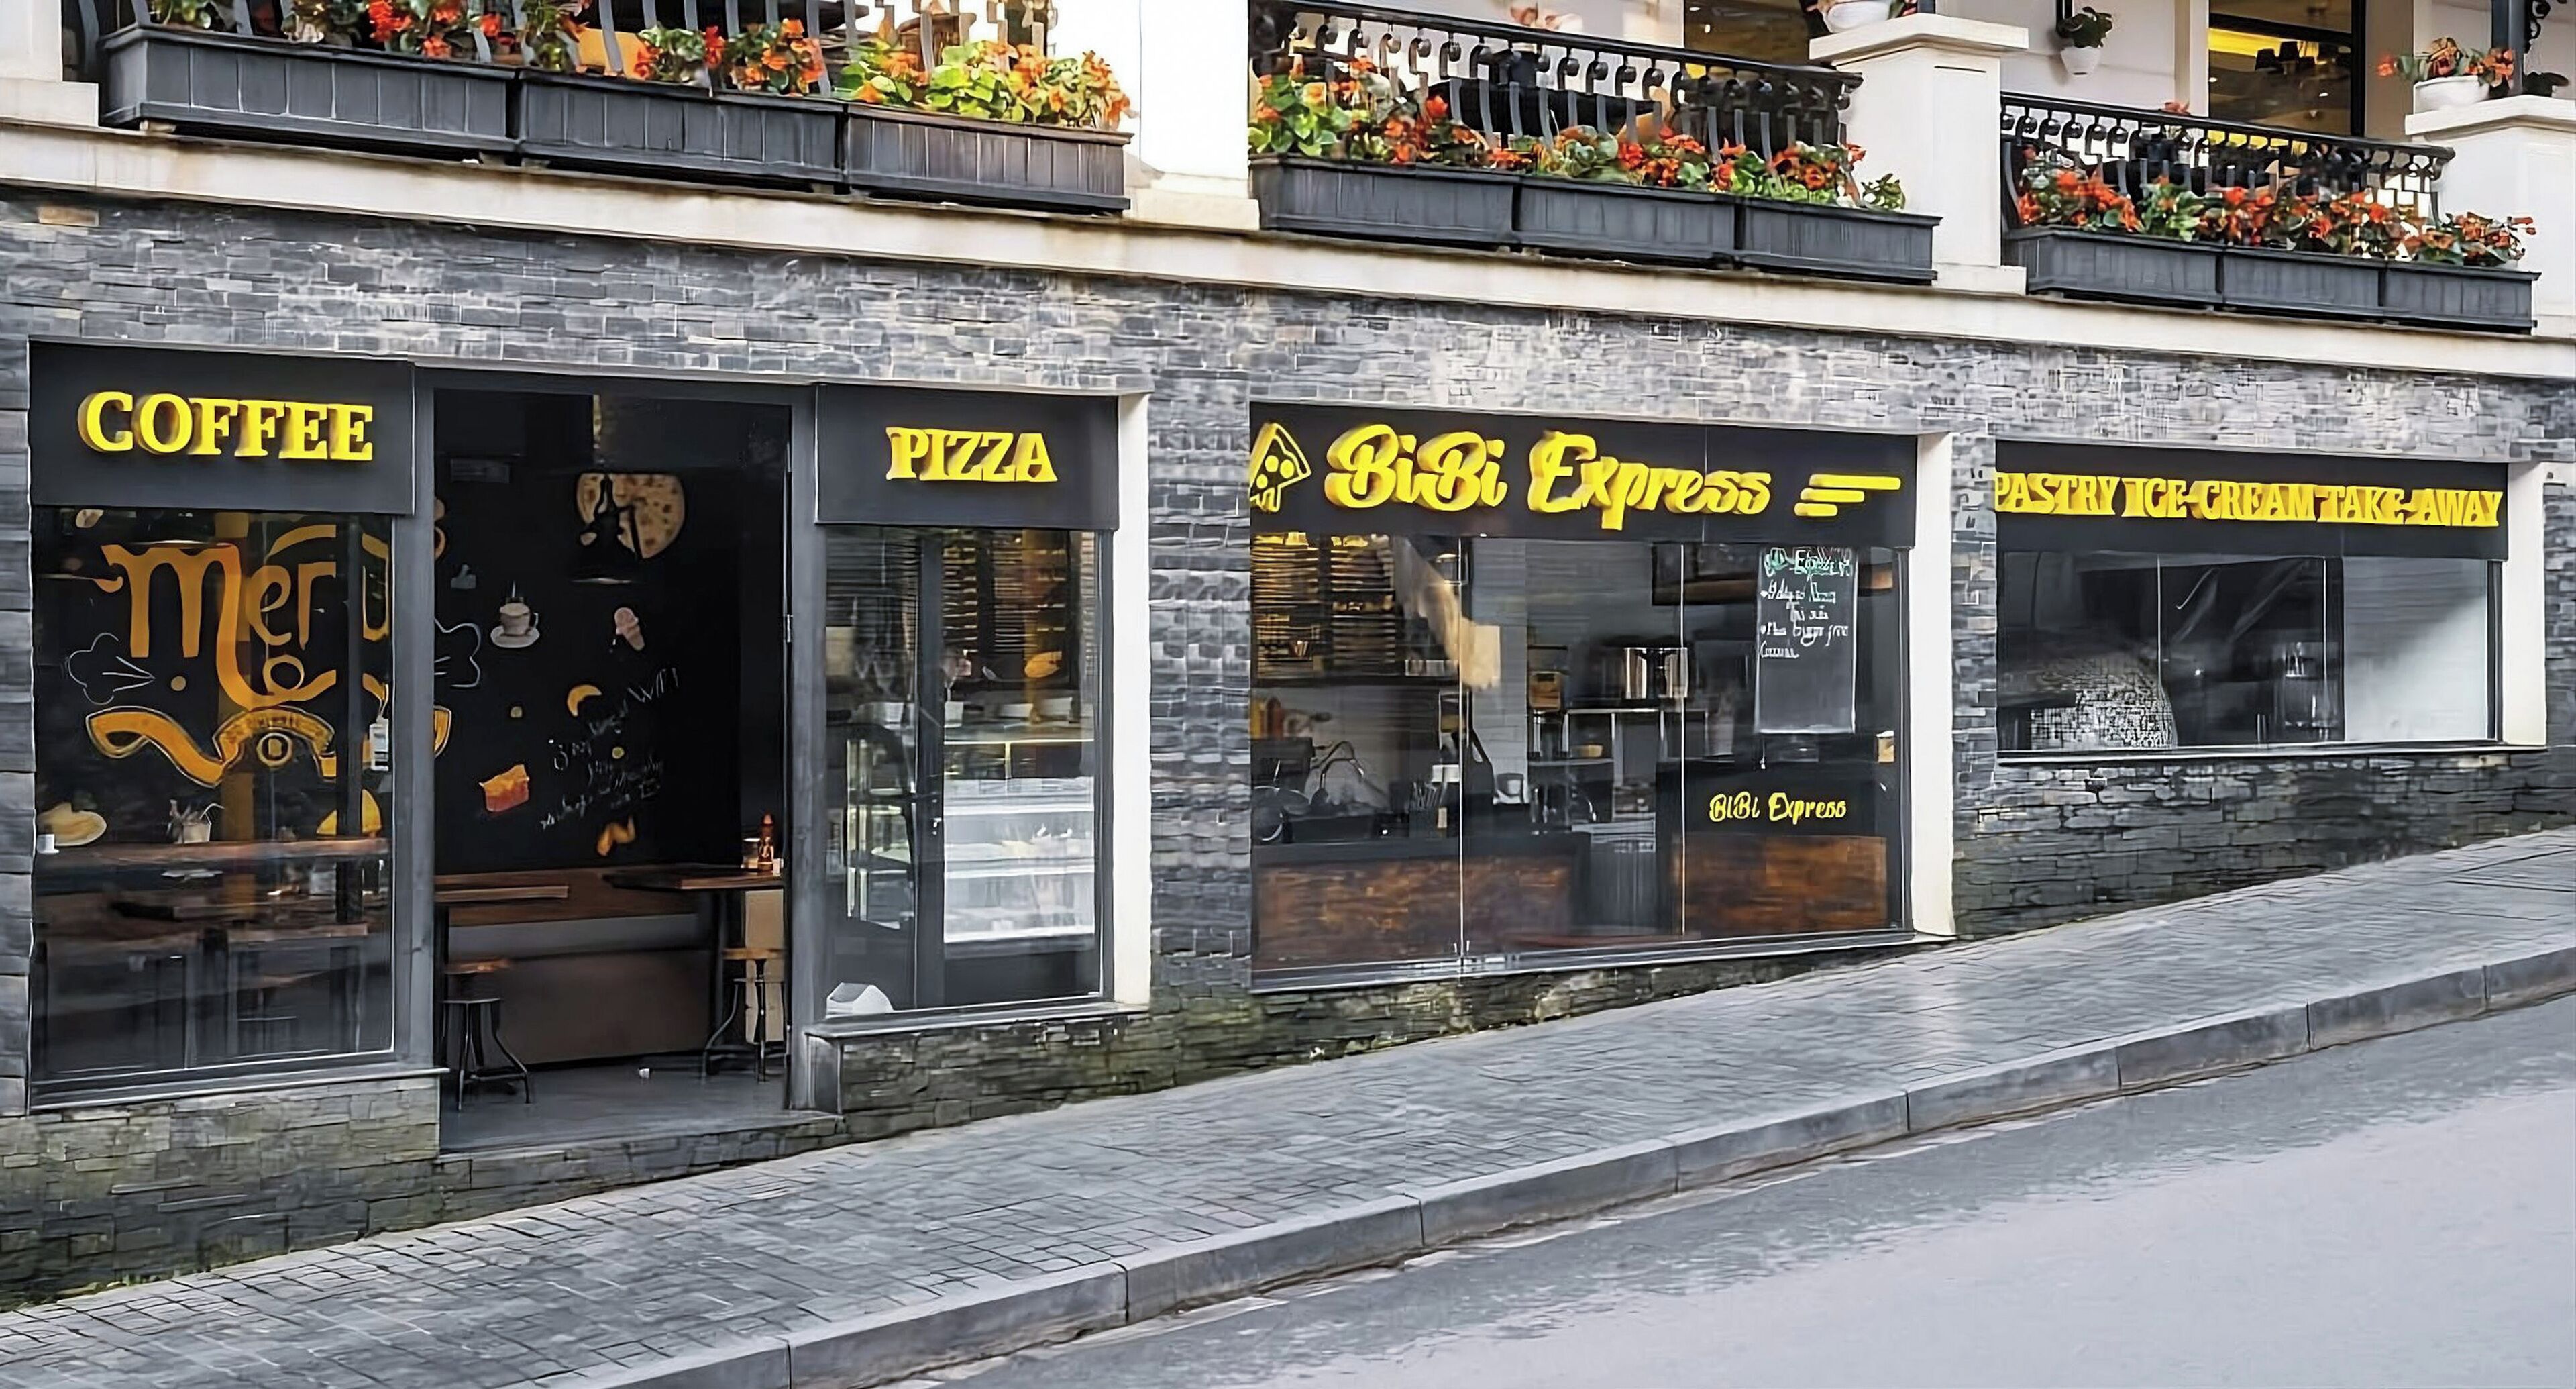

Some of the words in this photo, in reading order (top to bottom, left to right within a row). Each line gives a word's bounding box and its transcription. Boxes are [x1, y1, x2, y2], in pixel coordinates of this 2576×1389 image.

[79, 391, 374, 461] COFFEE
[885, 426, 1059, 483] PIZZA
[1324, 423, 1508, 512] BiBi
[1527, 430, 1772, 531] Express
[1995, 472, 2121, 515] PASTRY
[2121, 478, 2316, 521] ICE-CREAM
[2313, 485, 2504, 527] TAKE-AWAY
[1768, 792, 1847, 825] Express
